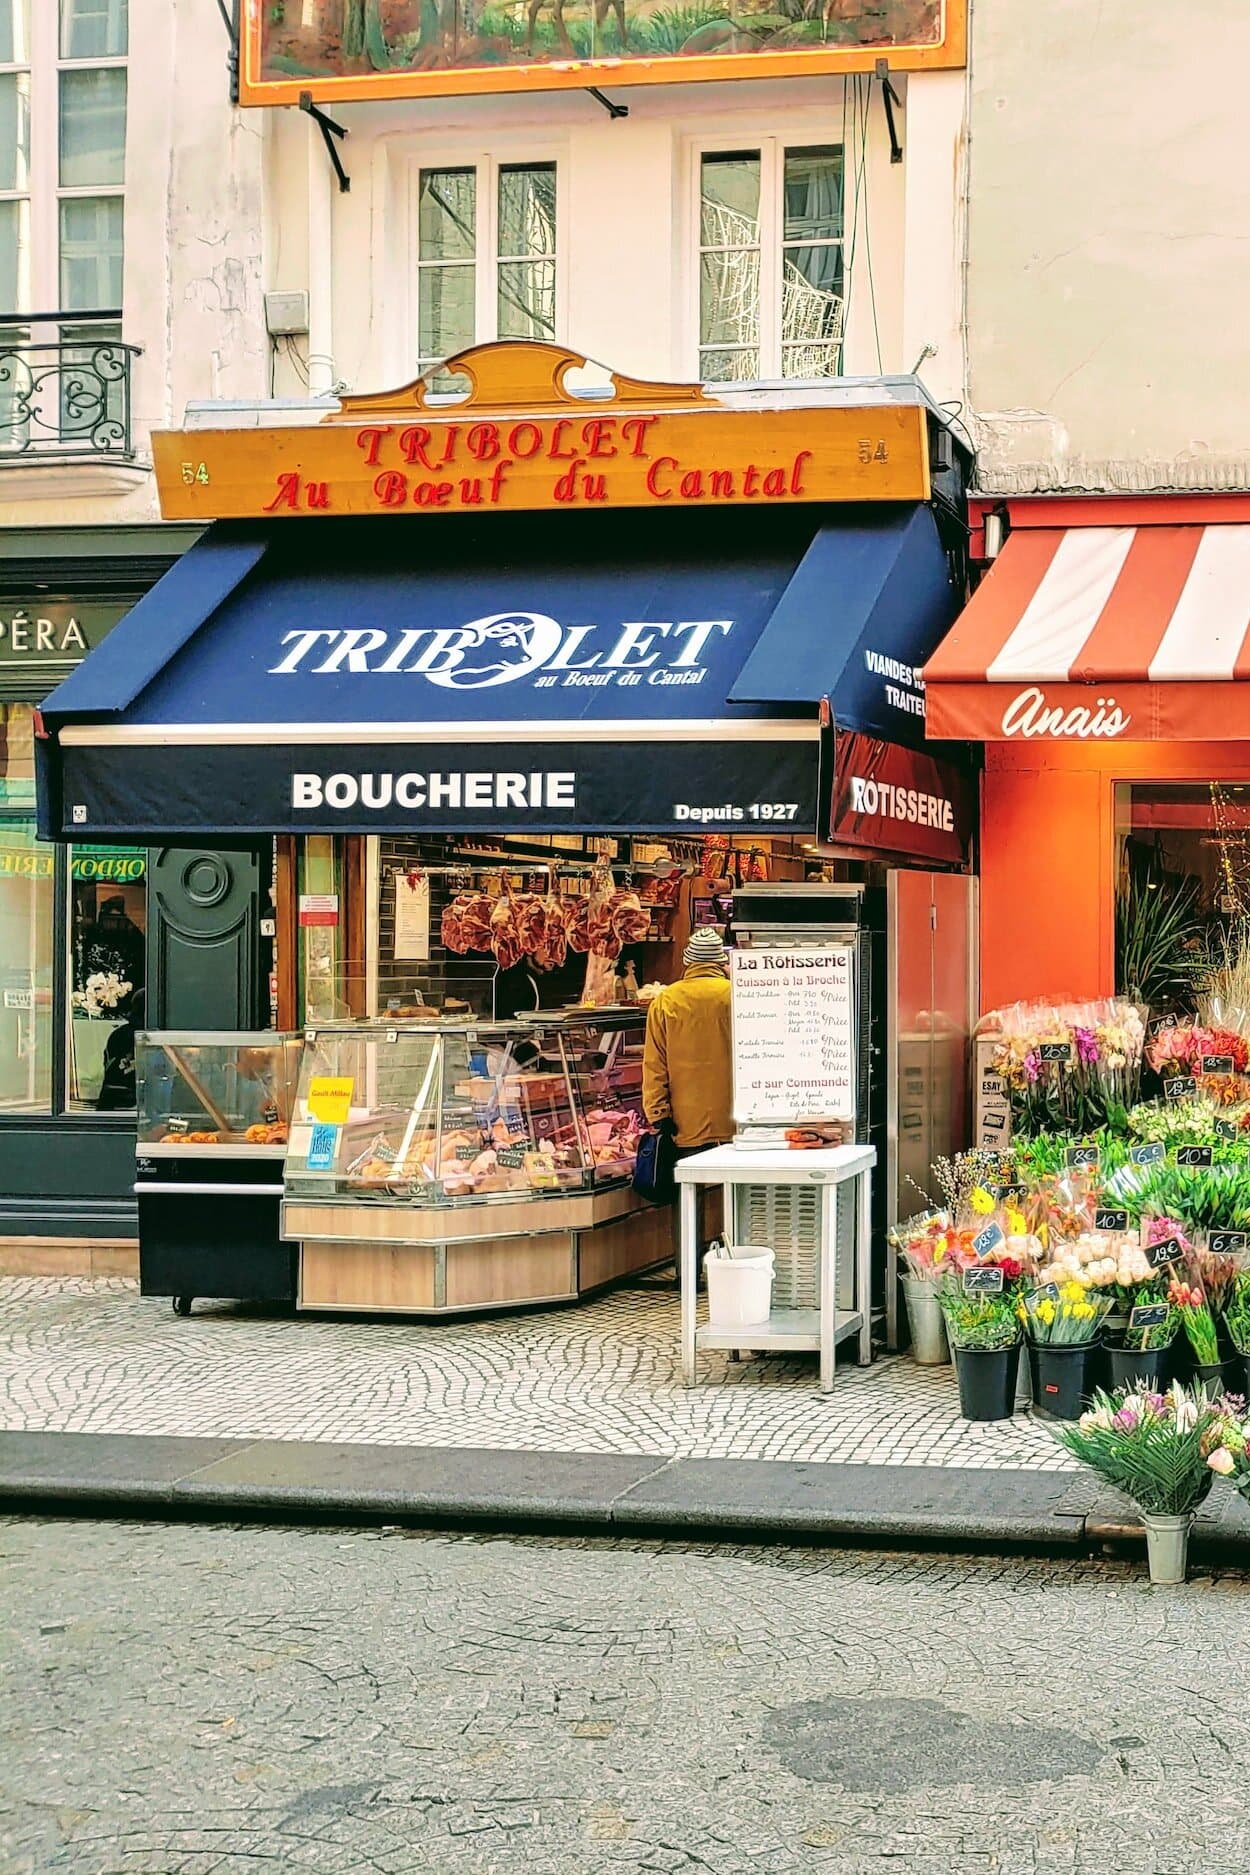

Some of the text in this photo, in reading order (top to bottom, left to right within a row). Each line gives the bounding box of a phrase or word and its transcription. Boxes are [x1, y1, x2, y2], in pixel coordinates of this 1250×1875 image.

[356, 414, 661, 471] TRIBOLET
[857, 438, 889, 465] 54
[181, 462, 210, 486] 54
[262, 471, 332, 512] Au
[552, 459, 608, 502] du
[645, 450, 813, 499] Cantal
[865, 649, 912, 686] VIANDES
[533, 666, 708, 689] au Boeuf du Cantal
[1002, 687, 1131, 739] Anaïs
[291, 771, 577, 809] BOUCHERIE
[674, 803, 799, 823] Depuis 1927
[737, 953, 847, 971] La Rôtisserie
[736, 977, 780, 988] Cuisson
[792, 976, 804, 987] la
[1043, 1043, 1070, 1059] 20€
[764, 1080, 784, 1089] sur
[786, 1075, 849, 1089] Commande
[1215, 1119, 1237, 1135] 6€
[1073, 1148, 1095, 1166] 8€
[1136, 1147, 1160, 1164] 6€
[1178, 1149, 1210, 1165] 10€
[1095, 1213, 1125, 1229] 10€
[1212, 1235, 1240, 1251] 6€
[1152, 1242, 1179, 1264] 12€
